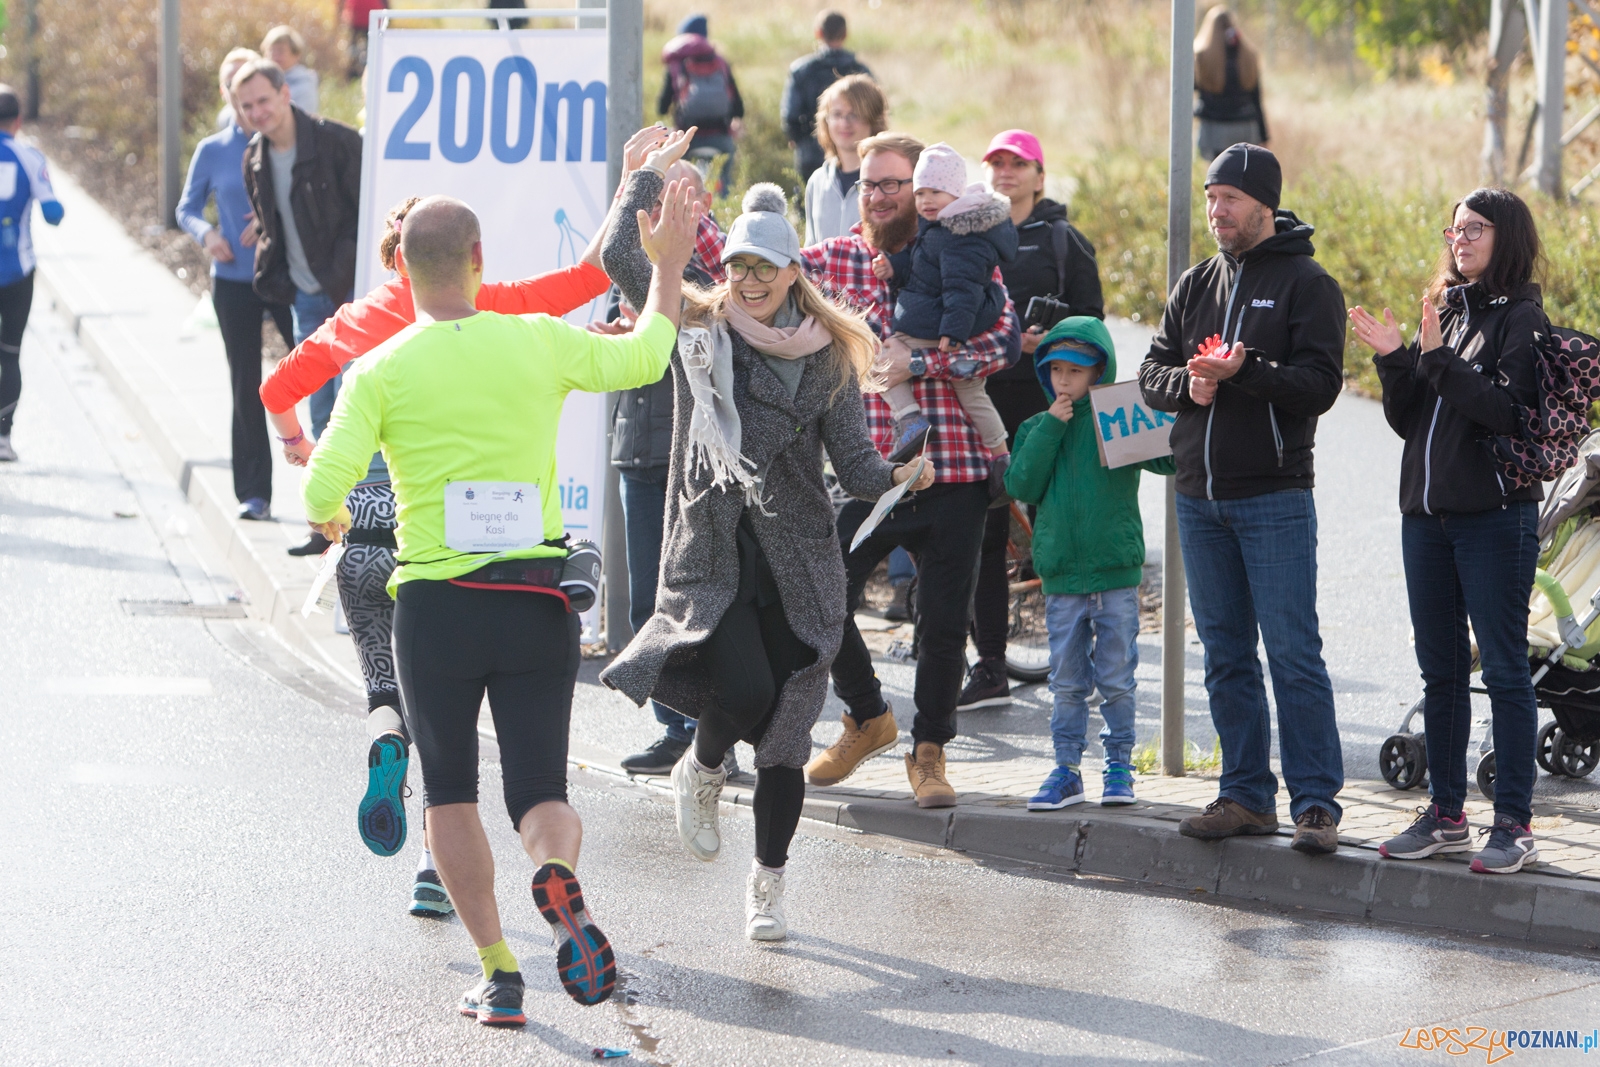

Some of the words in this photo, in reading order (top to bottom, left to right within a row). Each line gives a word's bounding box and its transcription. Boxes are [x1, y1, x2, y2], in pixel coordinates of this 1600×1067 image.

[384, 55, 607, 164] 200m
[470, 511, 502, 524] biegnę
[504, 511, 519, 521] dla
[485, 525, 506, 535] Kasi
